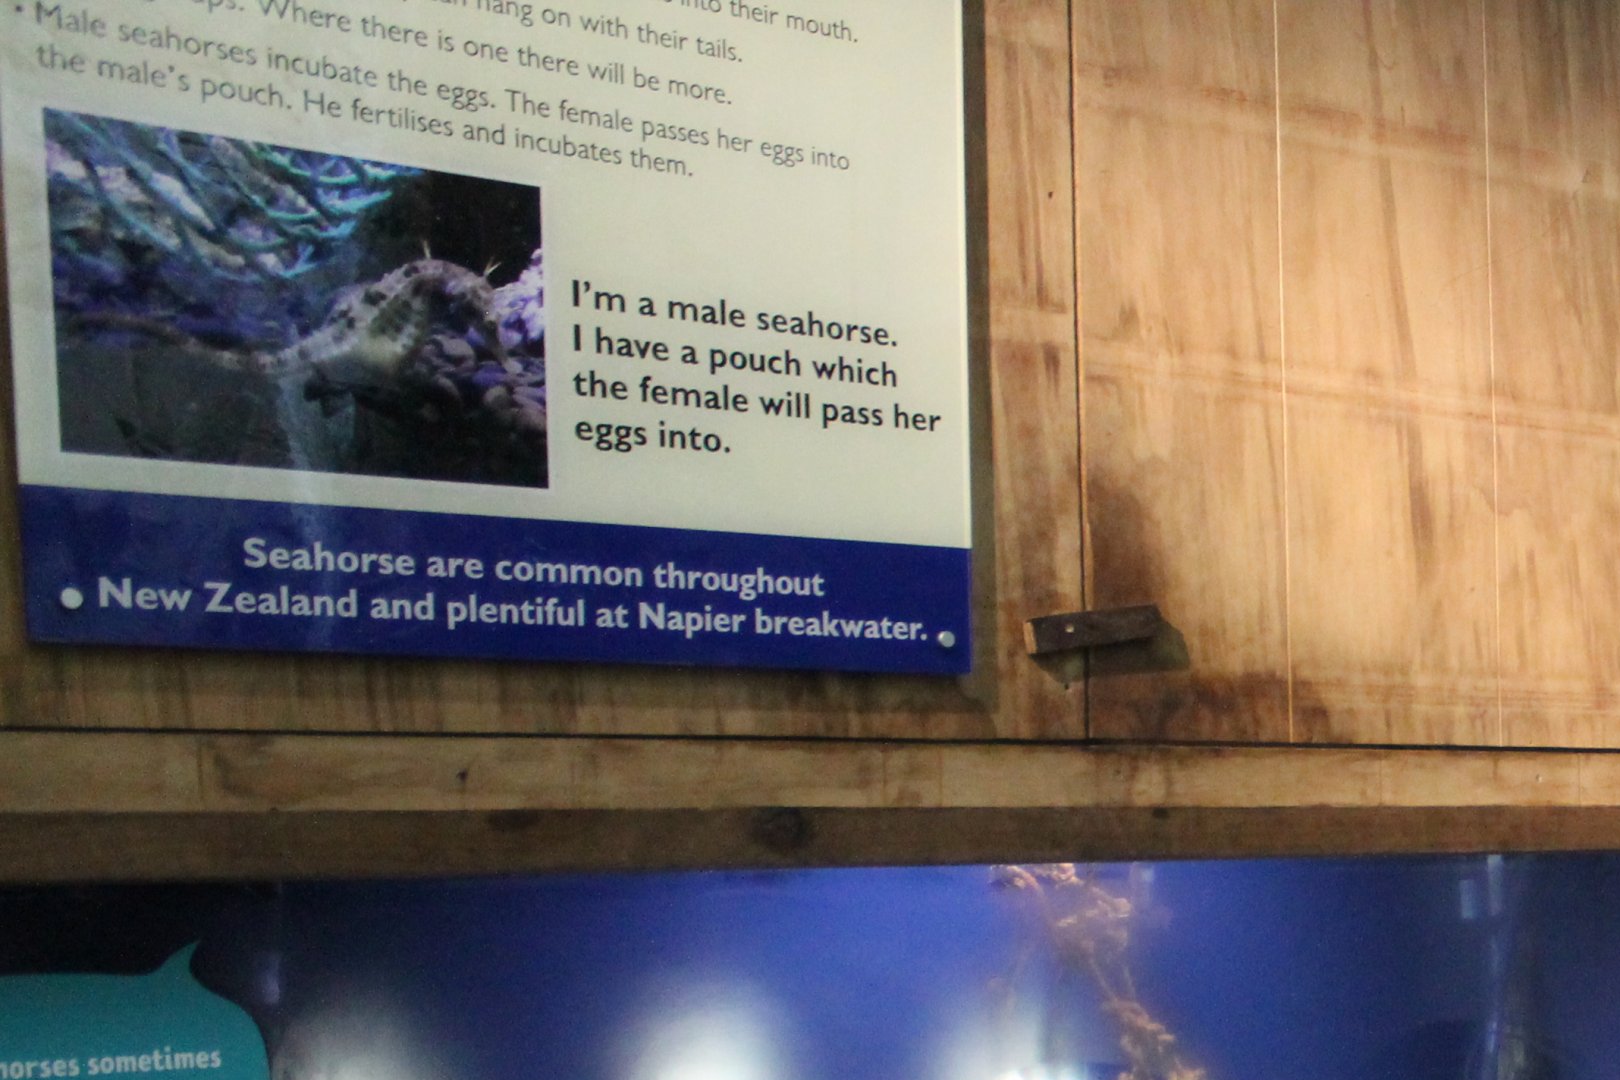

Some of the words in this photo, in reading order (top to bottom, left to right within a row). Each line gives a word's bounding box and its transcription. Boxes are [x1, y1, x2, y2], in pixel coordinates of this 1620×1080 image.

[260, 0, 351, 32] Where
[361, 15, 427, 47] there
[437, 29, 455, 52] is
[463, 40, 508, 62] one
[517, 46, 579, 76] there
[588, 62, 624, 85] will
[633, 66, 660, 91] be
[668, 79, 732, 105] more.
[541, 8, 571, 28] on
[580, 14, 628, 40] with
[637, 23, 688, 50] their
[696, 37, 742, 62] tails.
[729, 0, 779, 25] their
[787, 14, 858, 43] mouth.
[35, 1, 106, 38] Male
[118, 24, 257, 66] seahorses
[268, 47, 377, 87] incubate
[387, 69, 427, 96] the
[436, 82, 496, 113] eggs.
[504, 88, 550, 118] The
[558, 99, 633, 133] female
[641, 119, 709, 147] passes
[717, 128, 753, 153] her
[760, 141, 804, 168] eggs
[811, 146, 850, 170] into
[37, 45, 86, 74] the
[97, 60, 190, 93] male's
[201, 78, 292, 111] pouch.
[303, 89, 341, 118] He
[351, 98, 454, 138] fertilises
[462, 122, 505, 146] and
[514, 127, 622, 166] incubates
[630, 147, 693, 177] them.
[572, 279, 626, 313] I'm
[638, 295, 657, 317] a
[667, 299, 746, 328] male
[756, 310, 898, 348] seahorse.
[573, 324, 582, 352] I
[595, 327, 669, 362] have
[680, 344, 698, 366] a
[709, 346, 801, 376] pouch
[812, 355, 897, 388] which
[573, 371, 628, 400] the
[639, 375, 749, 413] female
[759, 392, 811, 419] will
[821, 400, 883, 430] pass
[893, 403, 941, 431] her
[575, 421, 647, 452] eggs
[658, 420, 731, 454] into.
[243, 537, 415, 576] Seahorse
[426, 554, 484, 579] are
[495, 557, 642, 588] common
[652, 562, 825, 600] throughout
[98, 577, 193, 611] New
[203, 581, 358, 618] Zealand
[369, 592, 434, 621] and
[446, 595, 585, 630] plentiful
[595, 603, 628, 629] at
[638, 602, 745, 639] Napier
[754, 608, 928, 641] breakwater.
[87, 1046, 222, 1076] sometimes
